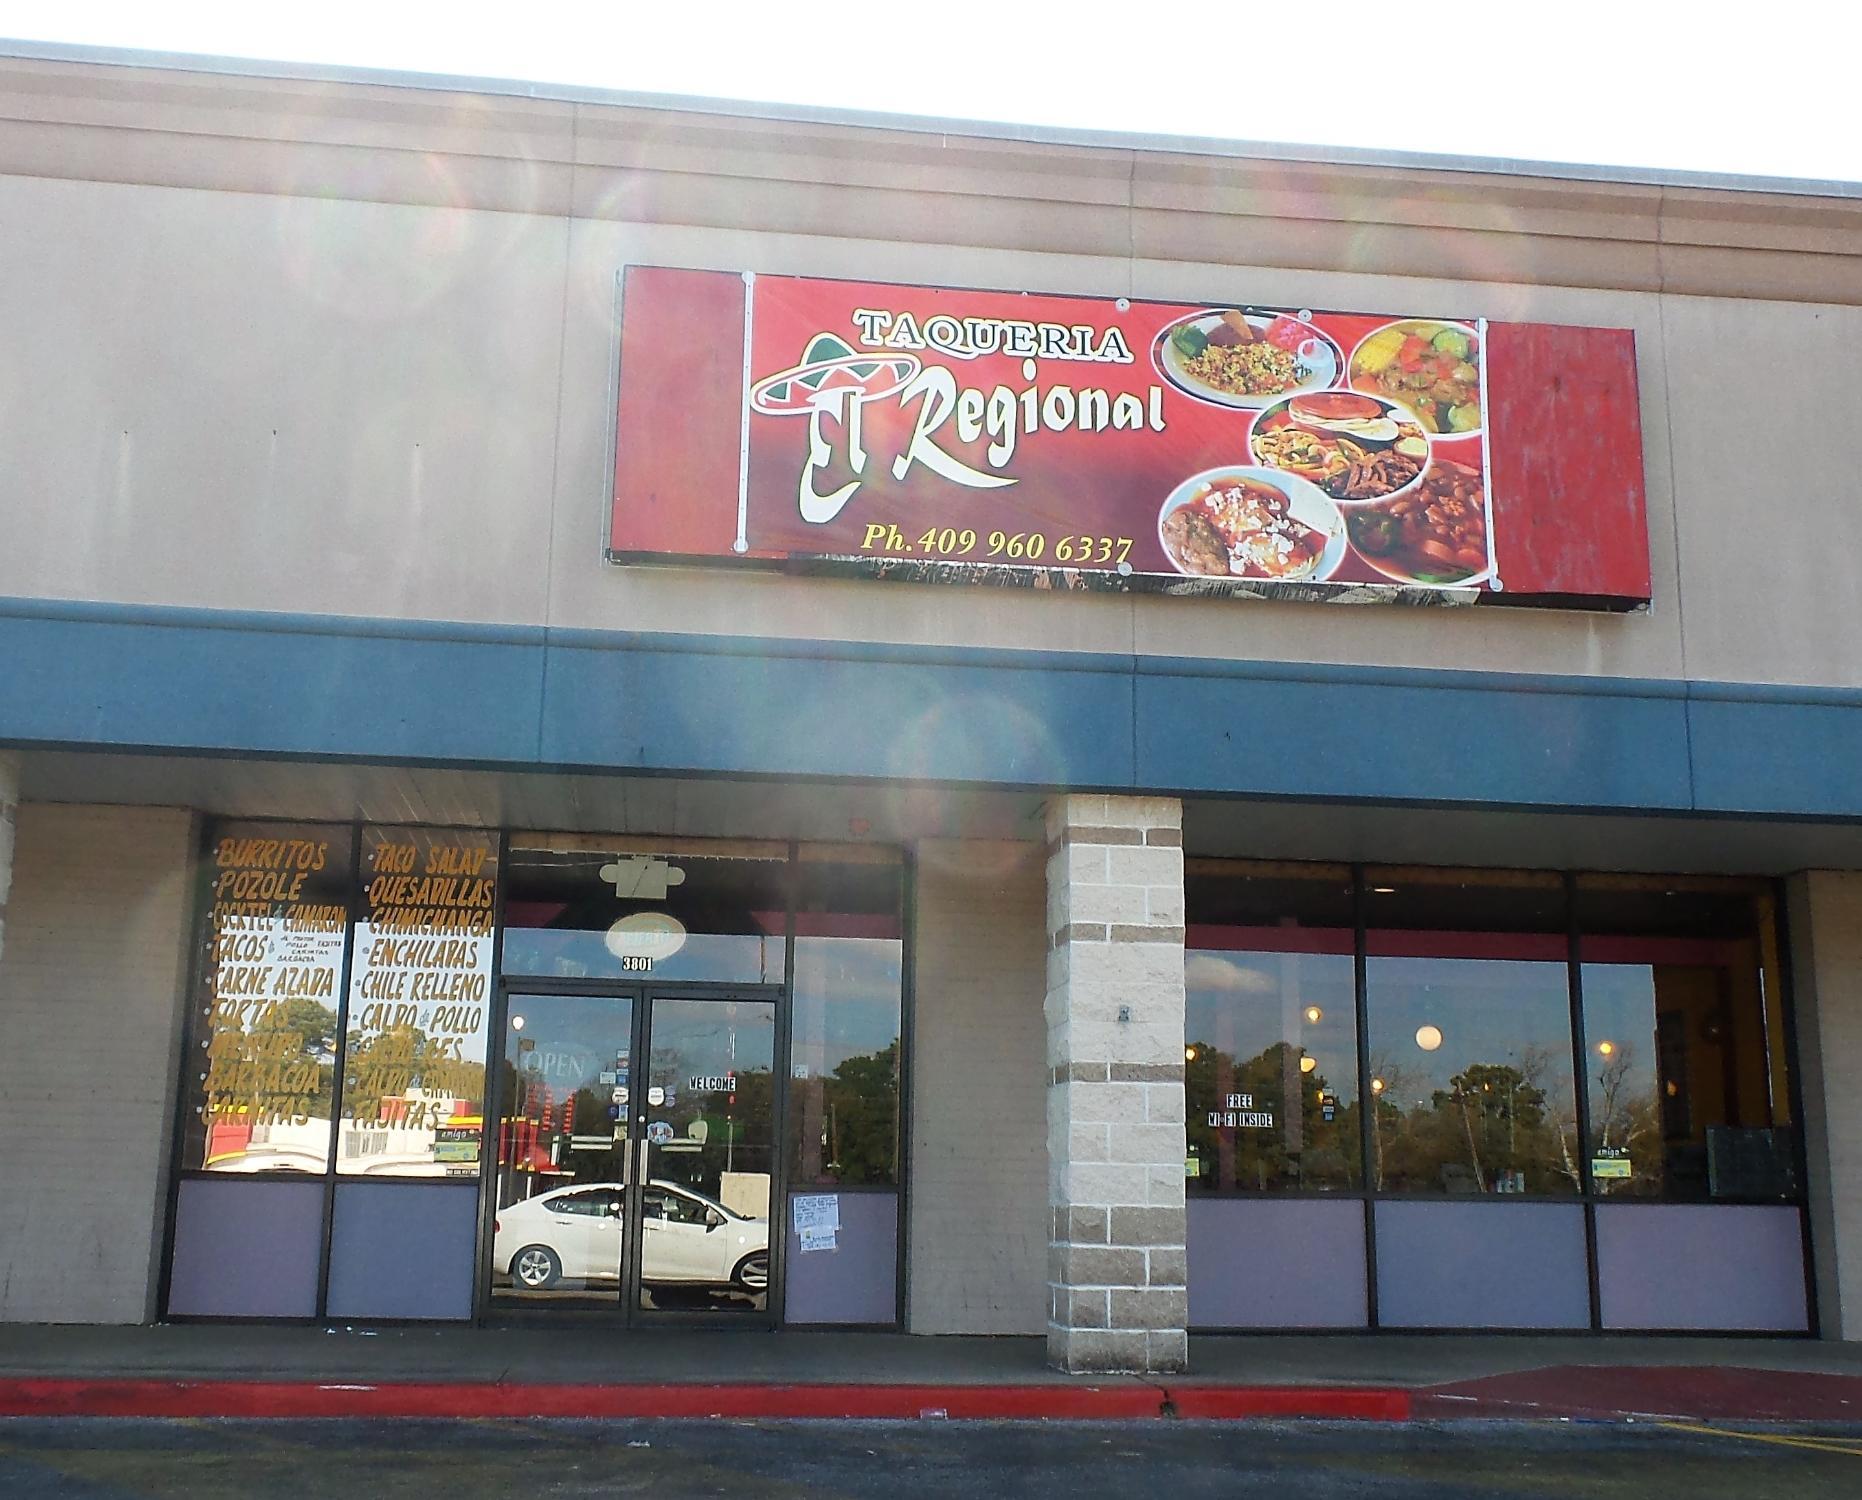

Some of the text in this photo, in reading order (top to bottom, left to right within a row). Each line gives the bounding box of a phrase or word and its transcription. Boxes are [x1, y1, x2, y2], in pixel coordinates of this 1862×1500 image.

[852, 308, 1135, 364] TAQUERIA
[799, 358, 1166, 523] El Regional
[918, 528, 977, 556] 409
[988, 532, 1045, 558] 960
[1056, 536, 1134, 564] 6337
[216, 838, 328, 870] BURRITOS
[373, 844, 487, 875] TACO SALAD
[216, 870, 308, 901] POZOLE
[368, 875, 494, 907] QUESADILLAS
[213, 902, 273, 931] COCKTEL
[369, 906, 494, 938] CHIMICHANGA
[211, 934, 268, 962] TACOS
[368, 938, 478, 969] ENCHILADAS
[623, 957, 652, 970] 3801
[211, 966, 334, 996] CARNE AZADA
[360, 971, 486, 1002] CHILE RELLENO
[207, 998, 290, 1028] TORTAS
[360, 1003, 418, 1033] CALDO
[429, 1006, 482, 1034] POLLO
[203, 1063, 321, 1094] BARBACOA
[525, 1052, 584, 1079] OPEN
[690, 1077, 735, 1090] WELCOME
[201, 1096, 310, 1126] CARNITAS
[1227, 1095, 1252, 1107] FREE
[1240, 1114, 1272, 1127] INSIDE
